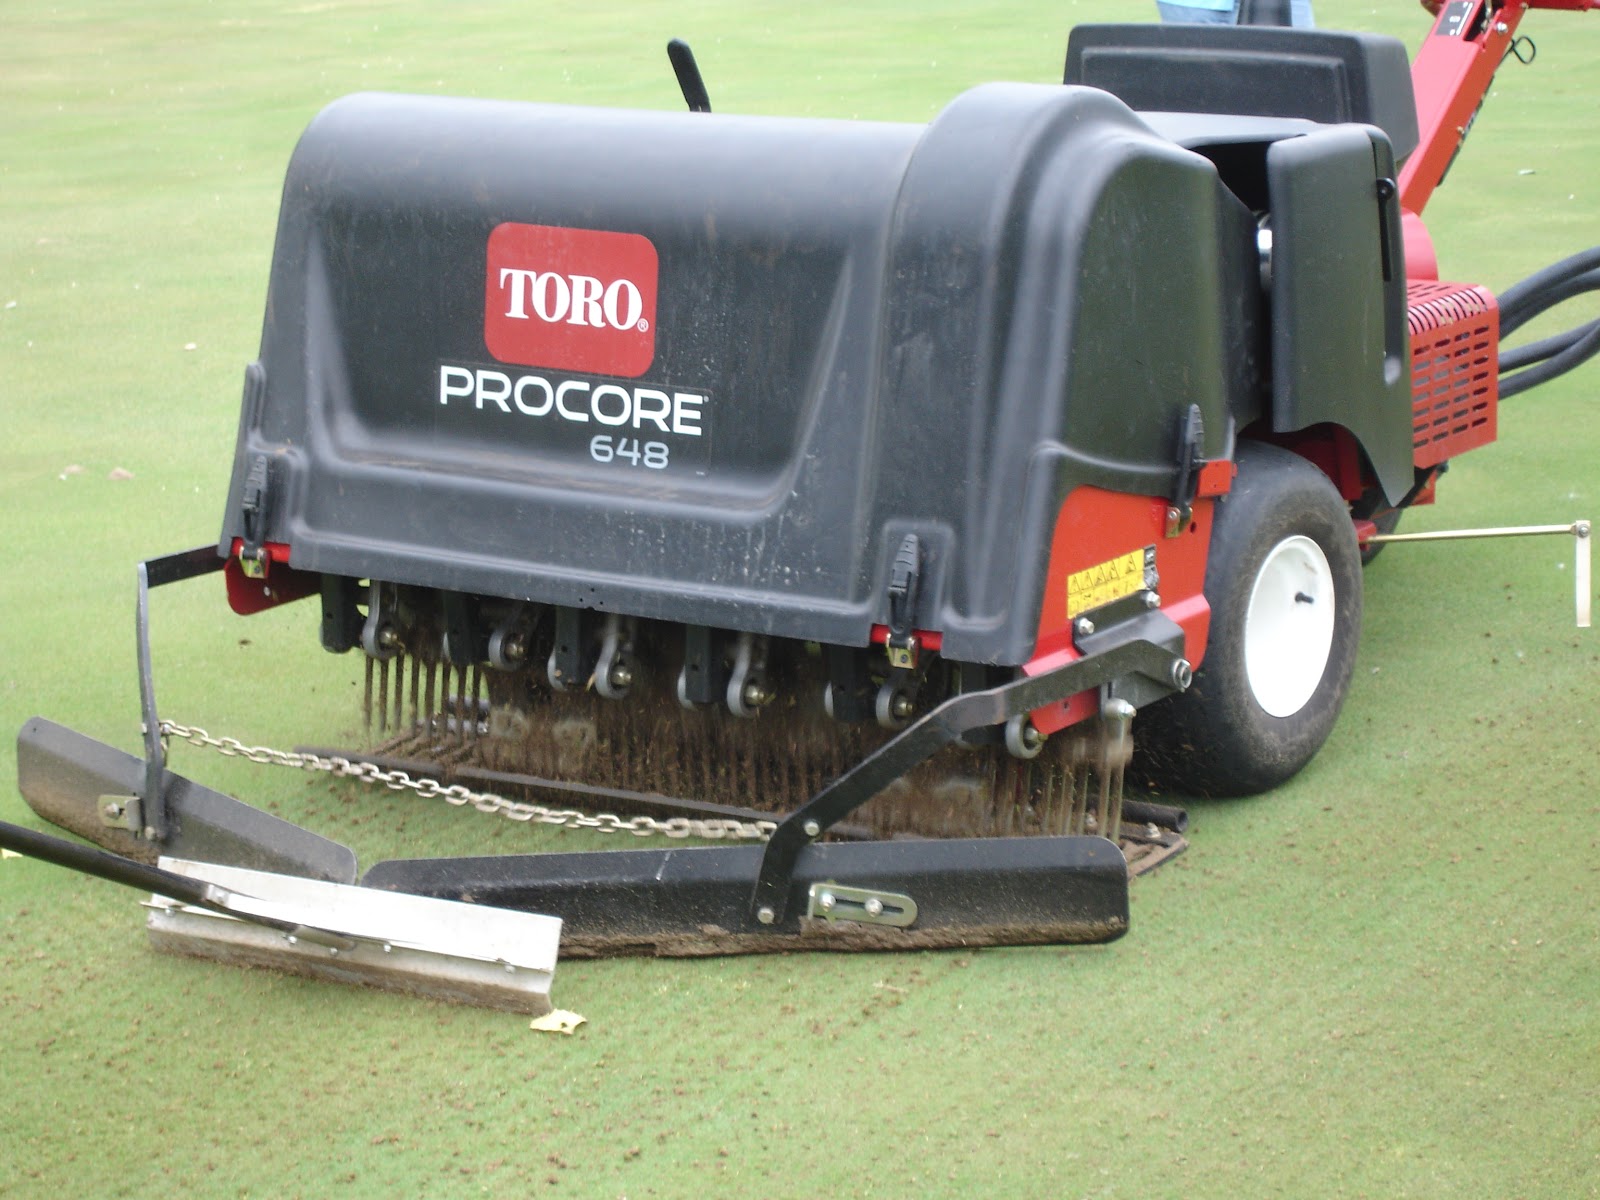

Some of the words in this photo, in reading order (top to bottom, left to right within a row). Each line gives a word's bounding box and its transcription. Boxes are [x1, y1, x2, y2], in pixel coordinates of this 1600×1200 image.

[500, 268, 644, 331] TORO
[440, 365, 703, 436] PROCORE
[589, 434, 670, 470] 648
